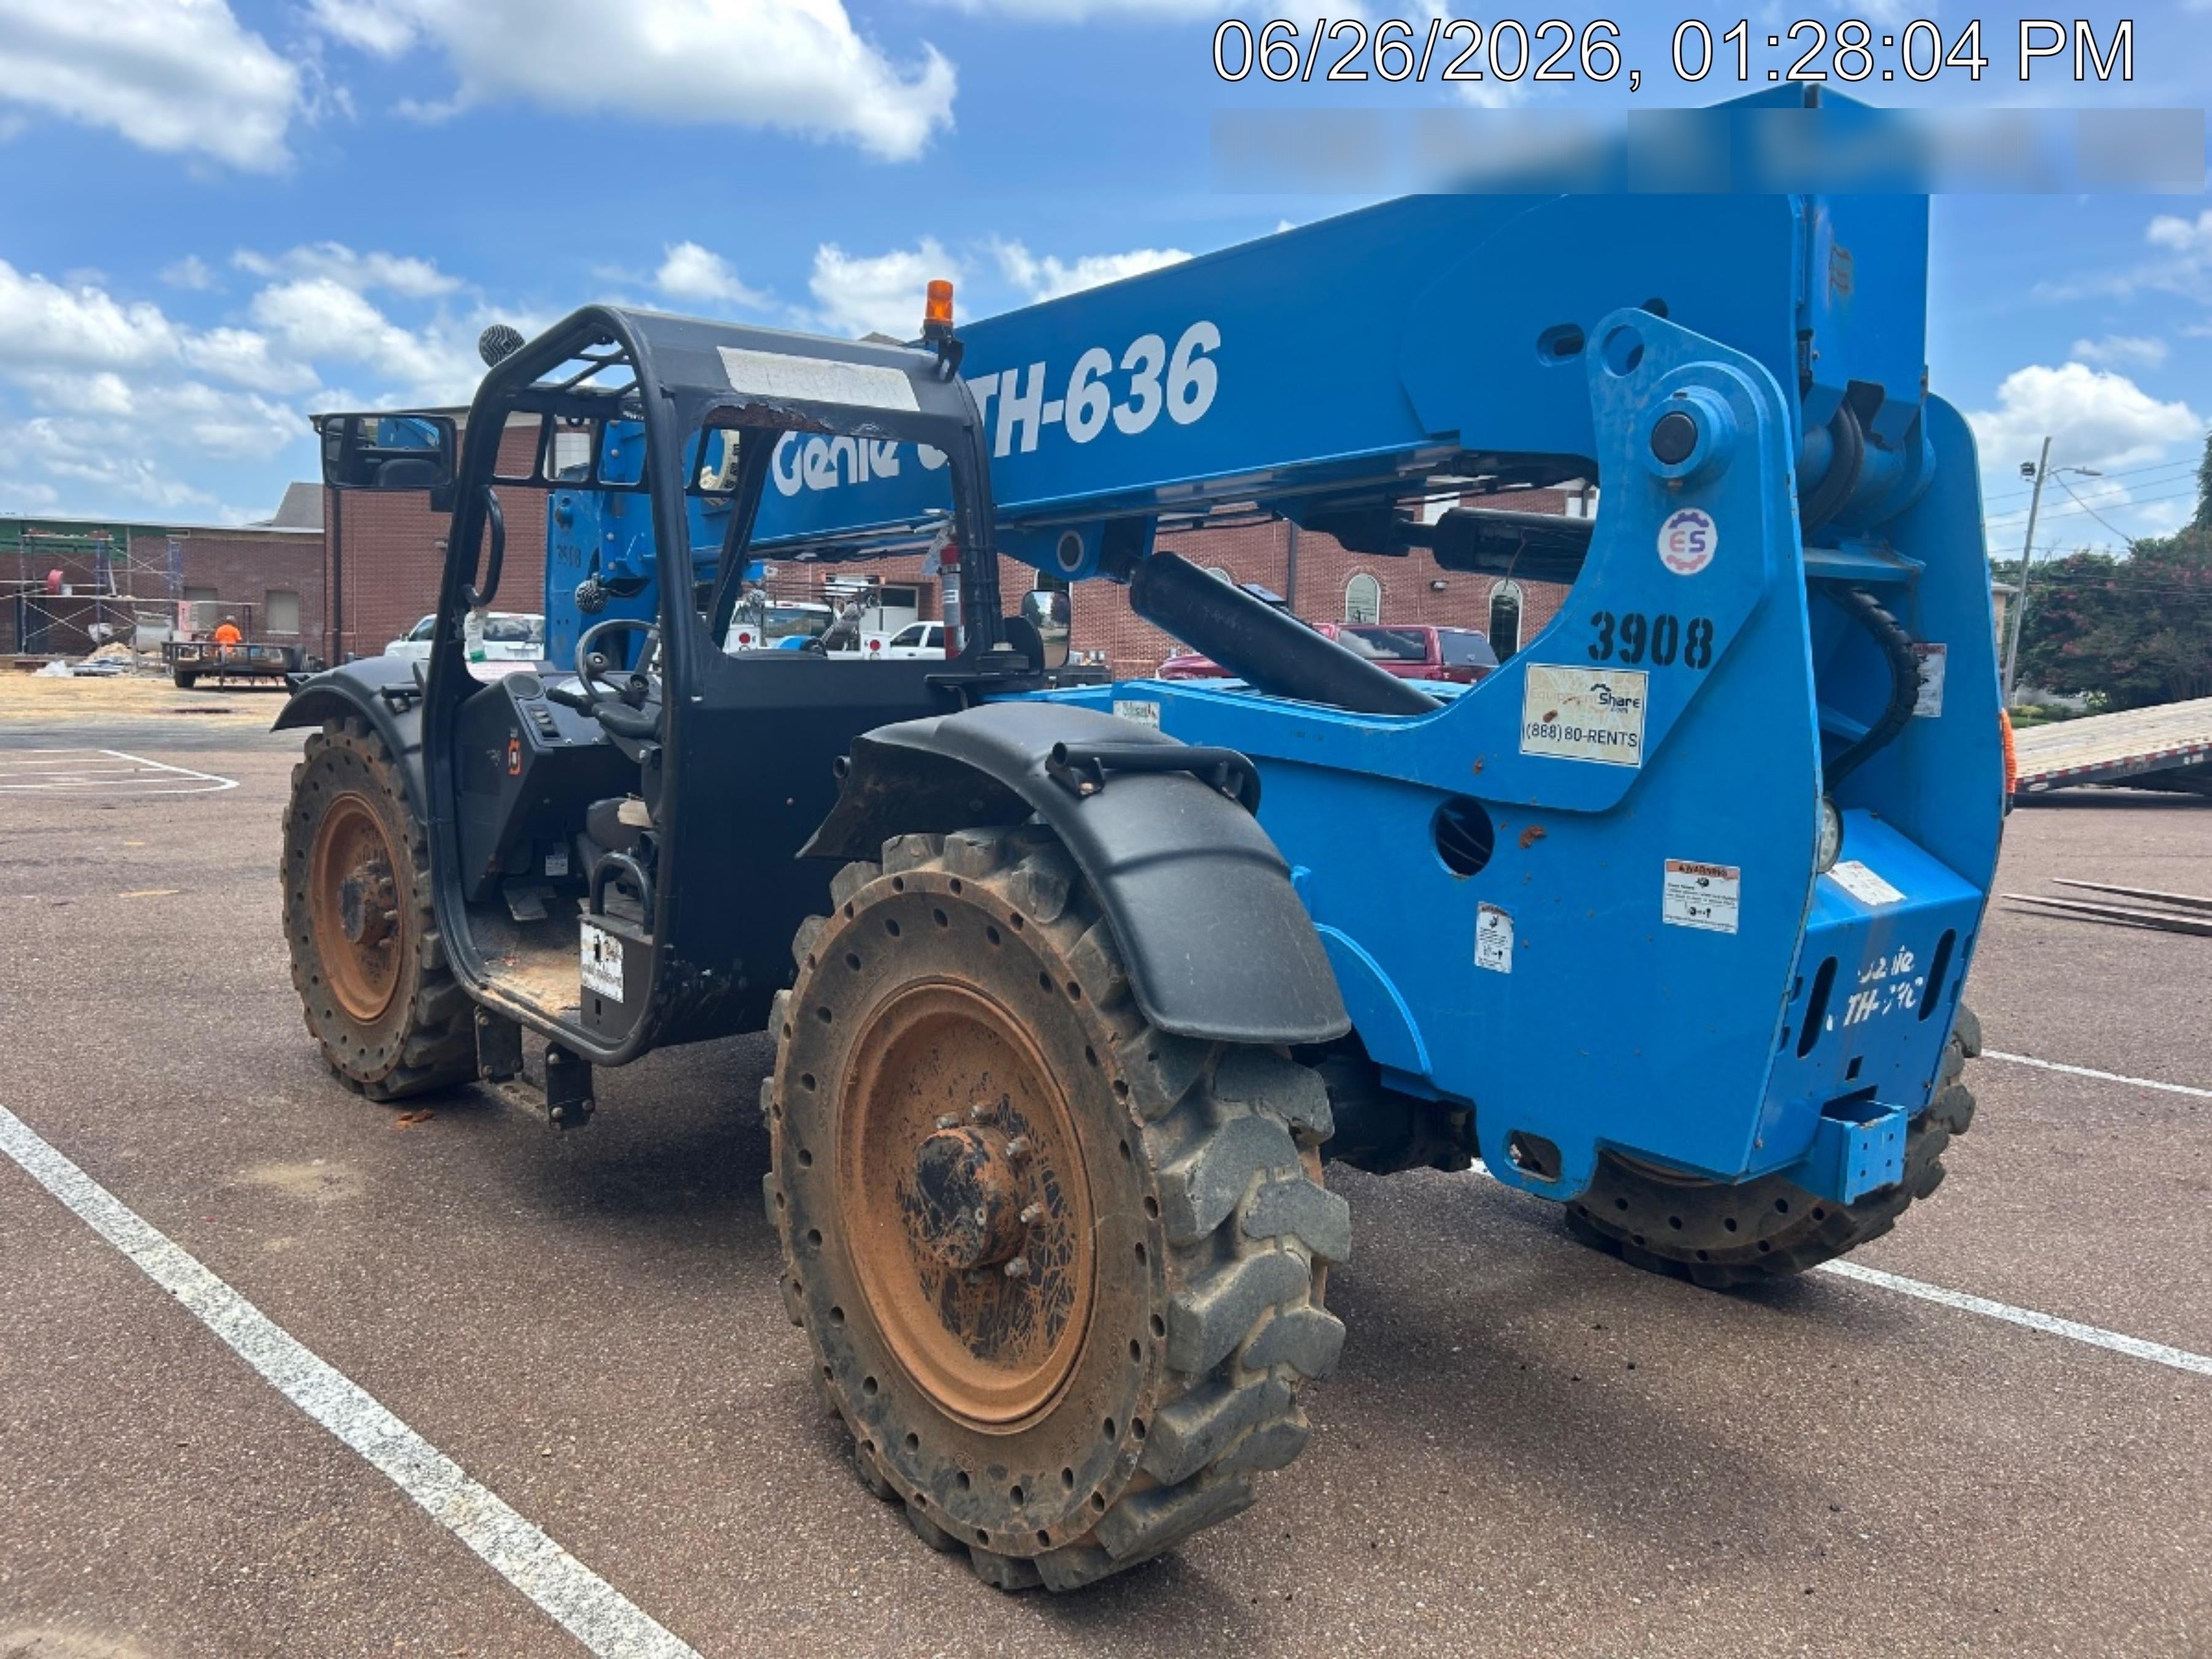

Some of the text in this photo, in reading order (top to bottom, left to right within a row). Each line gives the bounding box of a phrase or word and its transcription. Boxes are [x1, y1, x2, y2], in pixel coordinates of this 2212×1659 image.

[772, 430, 900, 497] Genie
[1669, 530, 1706, 552] ES
[1588, 611, 1713, 670] 3908
[1564, 726, 1637, 748] 80-RENTS
